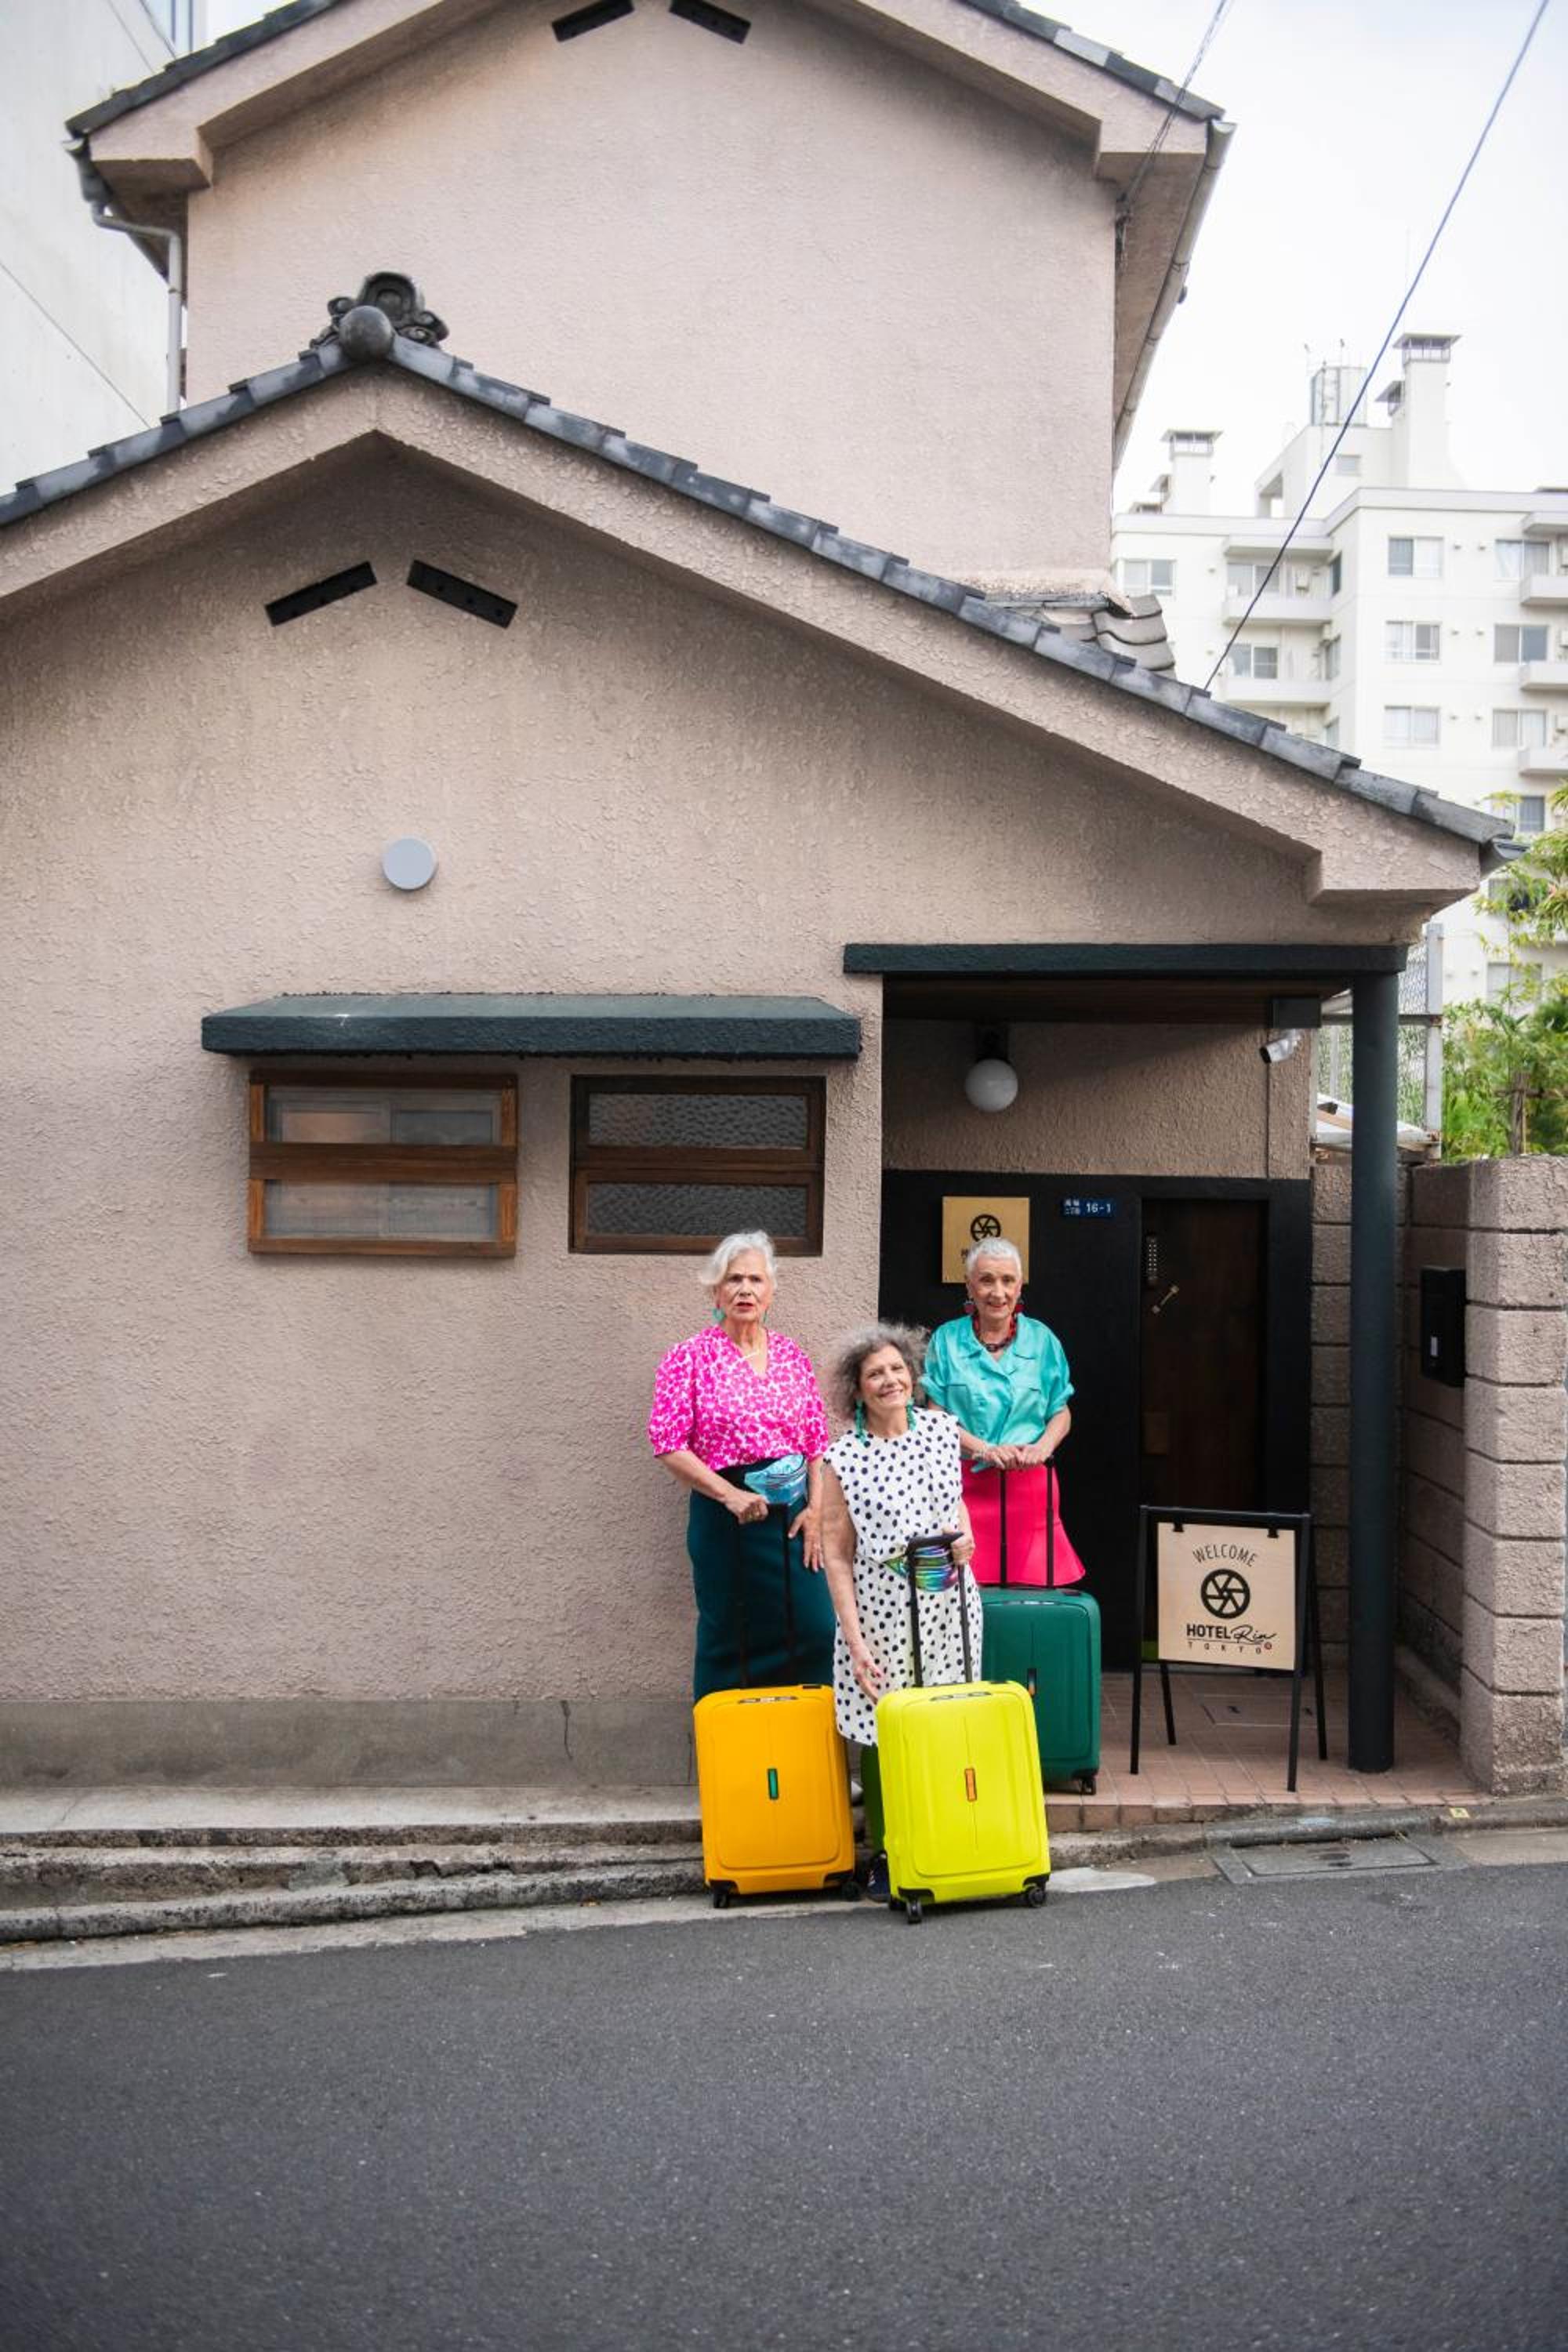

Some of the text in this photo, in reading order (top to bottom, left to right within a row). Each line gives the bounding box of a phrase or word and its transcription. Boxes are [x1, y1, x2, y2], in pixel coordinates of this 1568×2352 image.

[1087, 1203, 1111, 1214] 16-1
[1192, 1544, 1258, 1567] WELCOME
[1186, 1623, 1231, 1639] HOTEL
[1188, 1642, 1261, 1655] TOKYO
